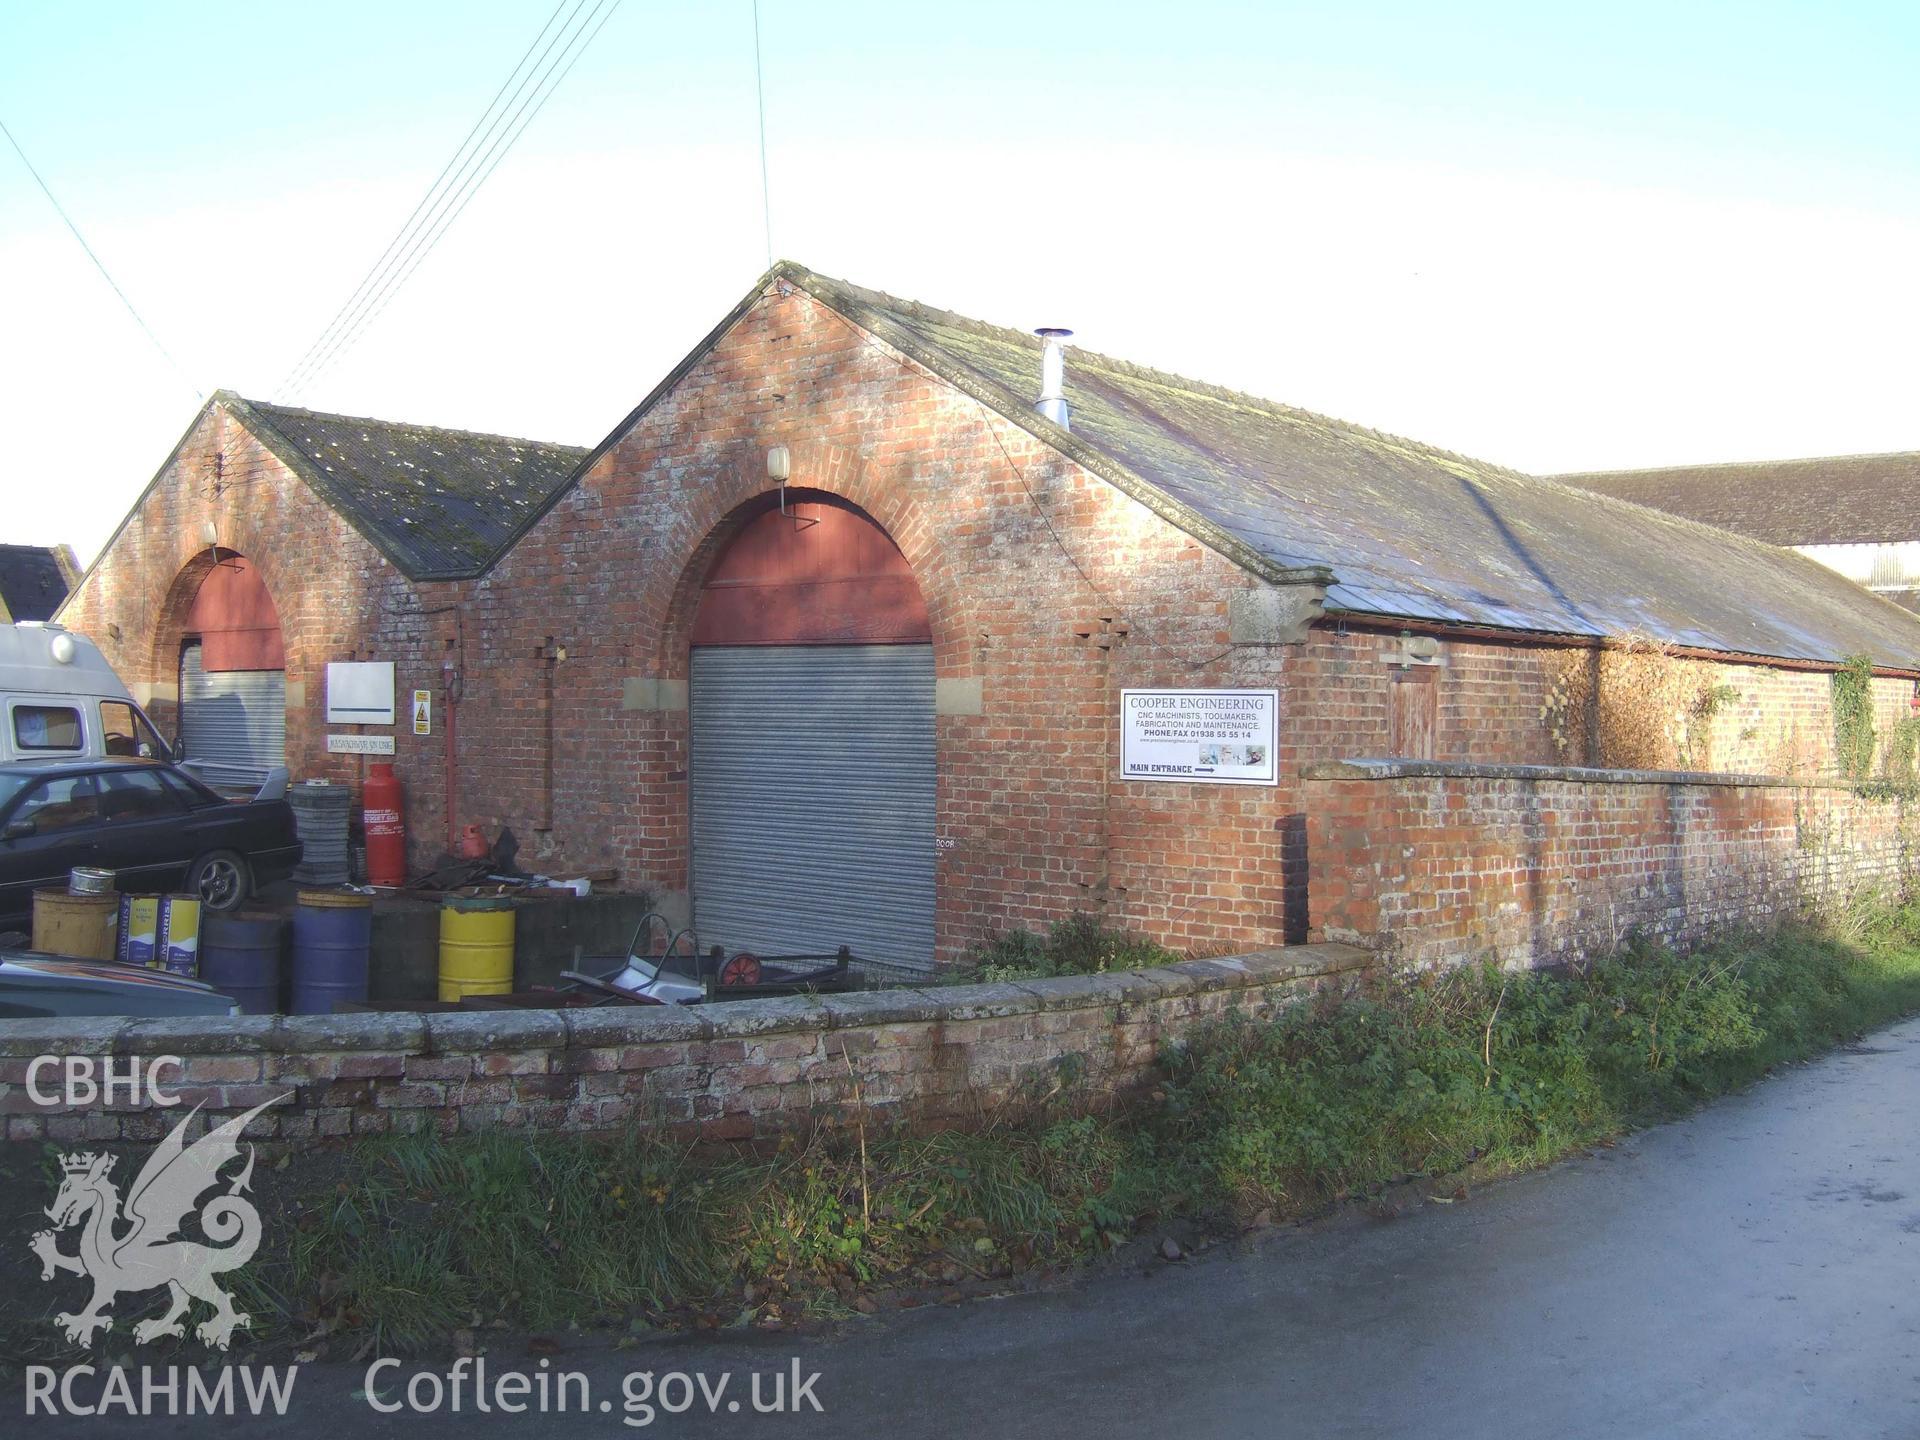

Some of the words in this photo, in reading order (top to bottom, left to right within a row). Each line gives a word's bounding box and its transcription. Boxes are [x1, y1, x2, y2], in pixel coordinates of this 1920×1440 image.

[1130, 697, 1176, 709] COOPER
[1180, 698, 1264, 710] ENGINEERING
[1137, 711, 1154, 719] CNC
[1135, 720, 1184, 728] FABRICATION
[1190, 730, 1215, 738] 01938
[1242, 731, 1251, 739] 14
[1130, 764, 1149, 772] MAIN
[1151, 764, 1192, 773] ENTRANCE
[161, 906, 171, 955] MORRIS
